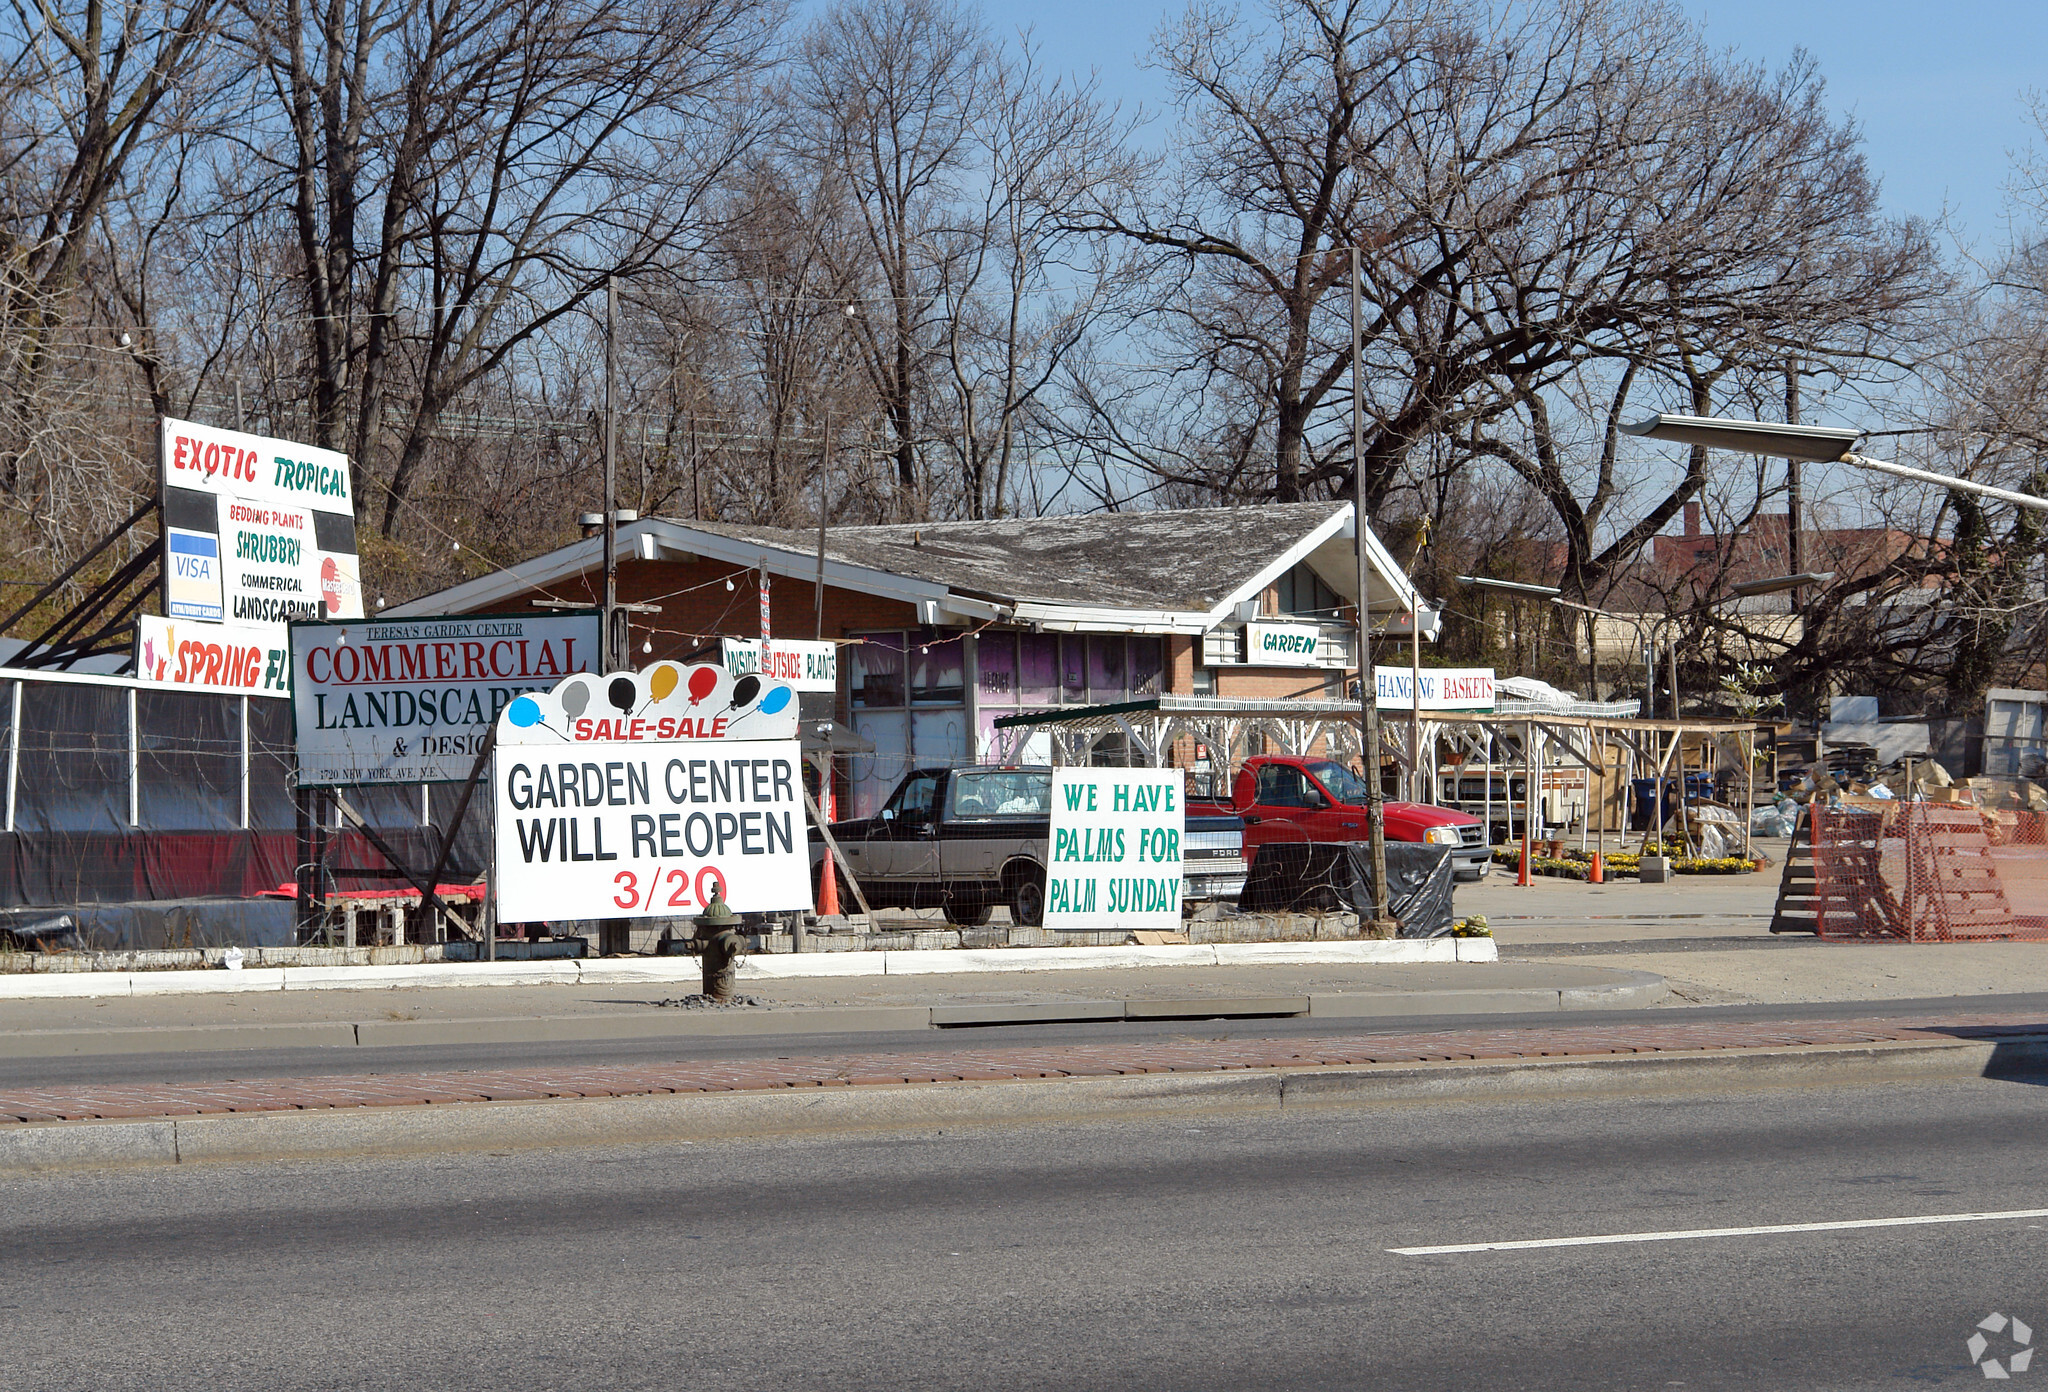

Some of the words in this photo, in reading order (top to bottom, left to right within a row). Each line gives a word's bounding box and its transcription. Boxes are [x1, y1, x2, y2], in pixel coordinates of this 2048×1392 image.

[174, 436, 258, 483] EXOTIC
[274, 456, 347, 498] TROPICAL
[230, 504, 270, 525] BEDDING
[272, 511, 304, 530] PLANTS
[236, 530, 301, 567] SHRUBBRY
[176, 556, 210, 580] VISA
[241, 573, 303, 593] COMMERICAL
[366, 626, 420, 640] TERESA'S
[424, 624, 472, 637] GARDEN
[476, 622, 523, 636] CENTER
[1263, 632, 1317, 654] GARDEN
[174, 640, 262, 688] SPRING
[306, 638, 587, 684] COMMERCIAL
[806, 653, 836, 680] PLANTS
[1377, 674, 1435, 699] HANGNG
[1443, 677, 1493, 700] BASKETS
[574, 717, 729, 741] SALE-SALE
[392, 737, 408, 757] &
[342, 768, 363, 780] NEW
[367, 767, 391, 780] YORK
[508, 762, 650, 810] GARDEN
[665, 759, 794, 804] CENTER
[1063, 784, 1099, 811] WE
[1113, 784, 1176, 812] HAVE
[516, 817, 617, 863] WILL
[631, 811, 793, 859] REOPEN
[1053, 828, 1126, 863] PALMS
[1138, 827, 1181, 863] FOR
[1212, 849, 1239, 857] FORD
[613, 866, 727, 912] 3/20
[1048, 878, 1097, 913] PALM
[1107, 878, 1181, 913] SUNDAY
